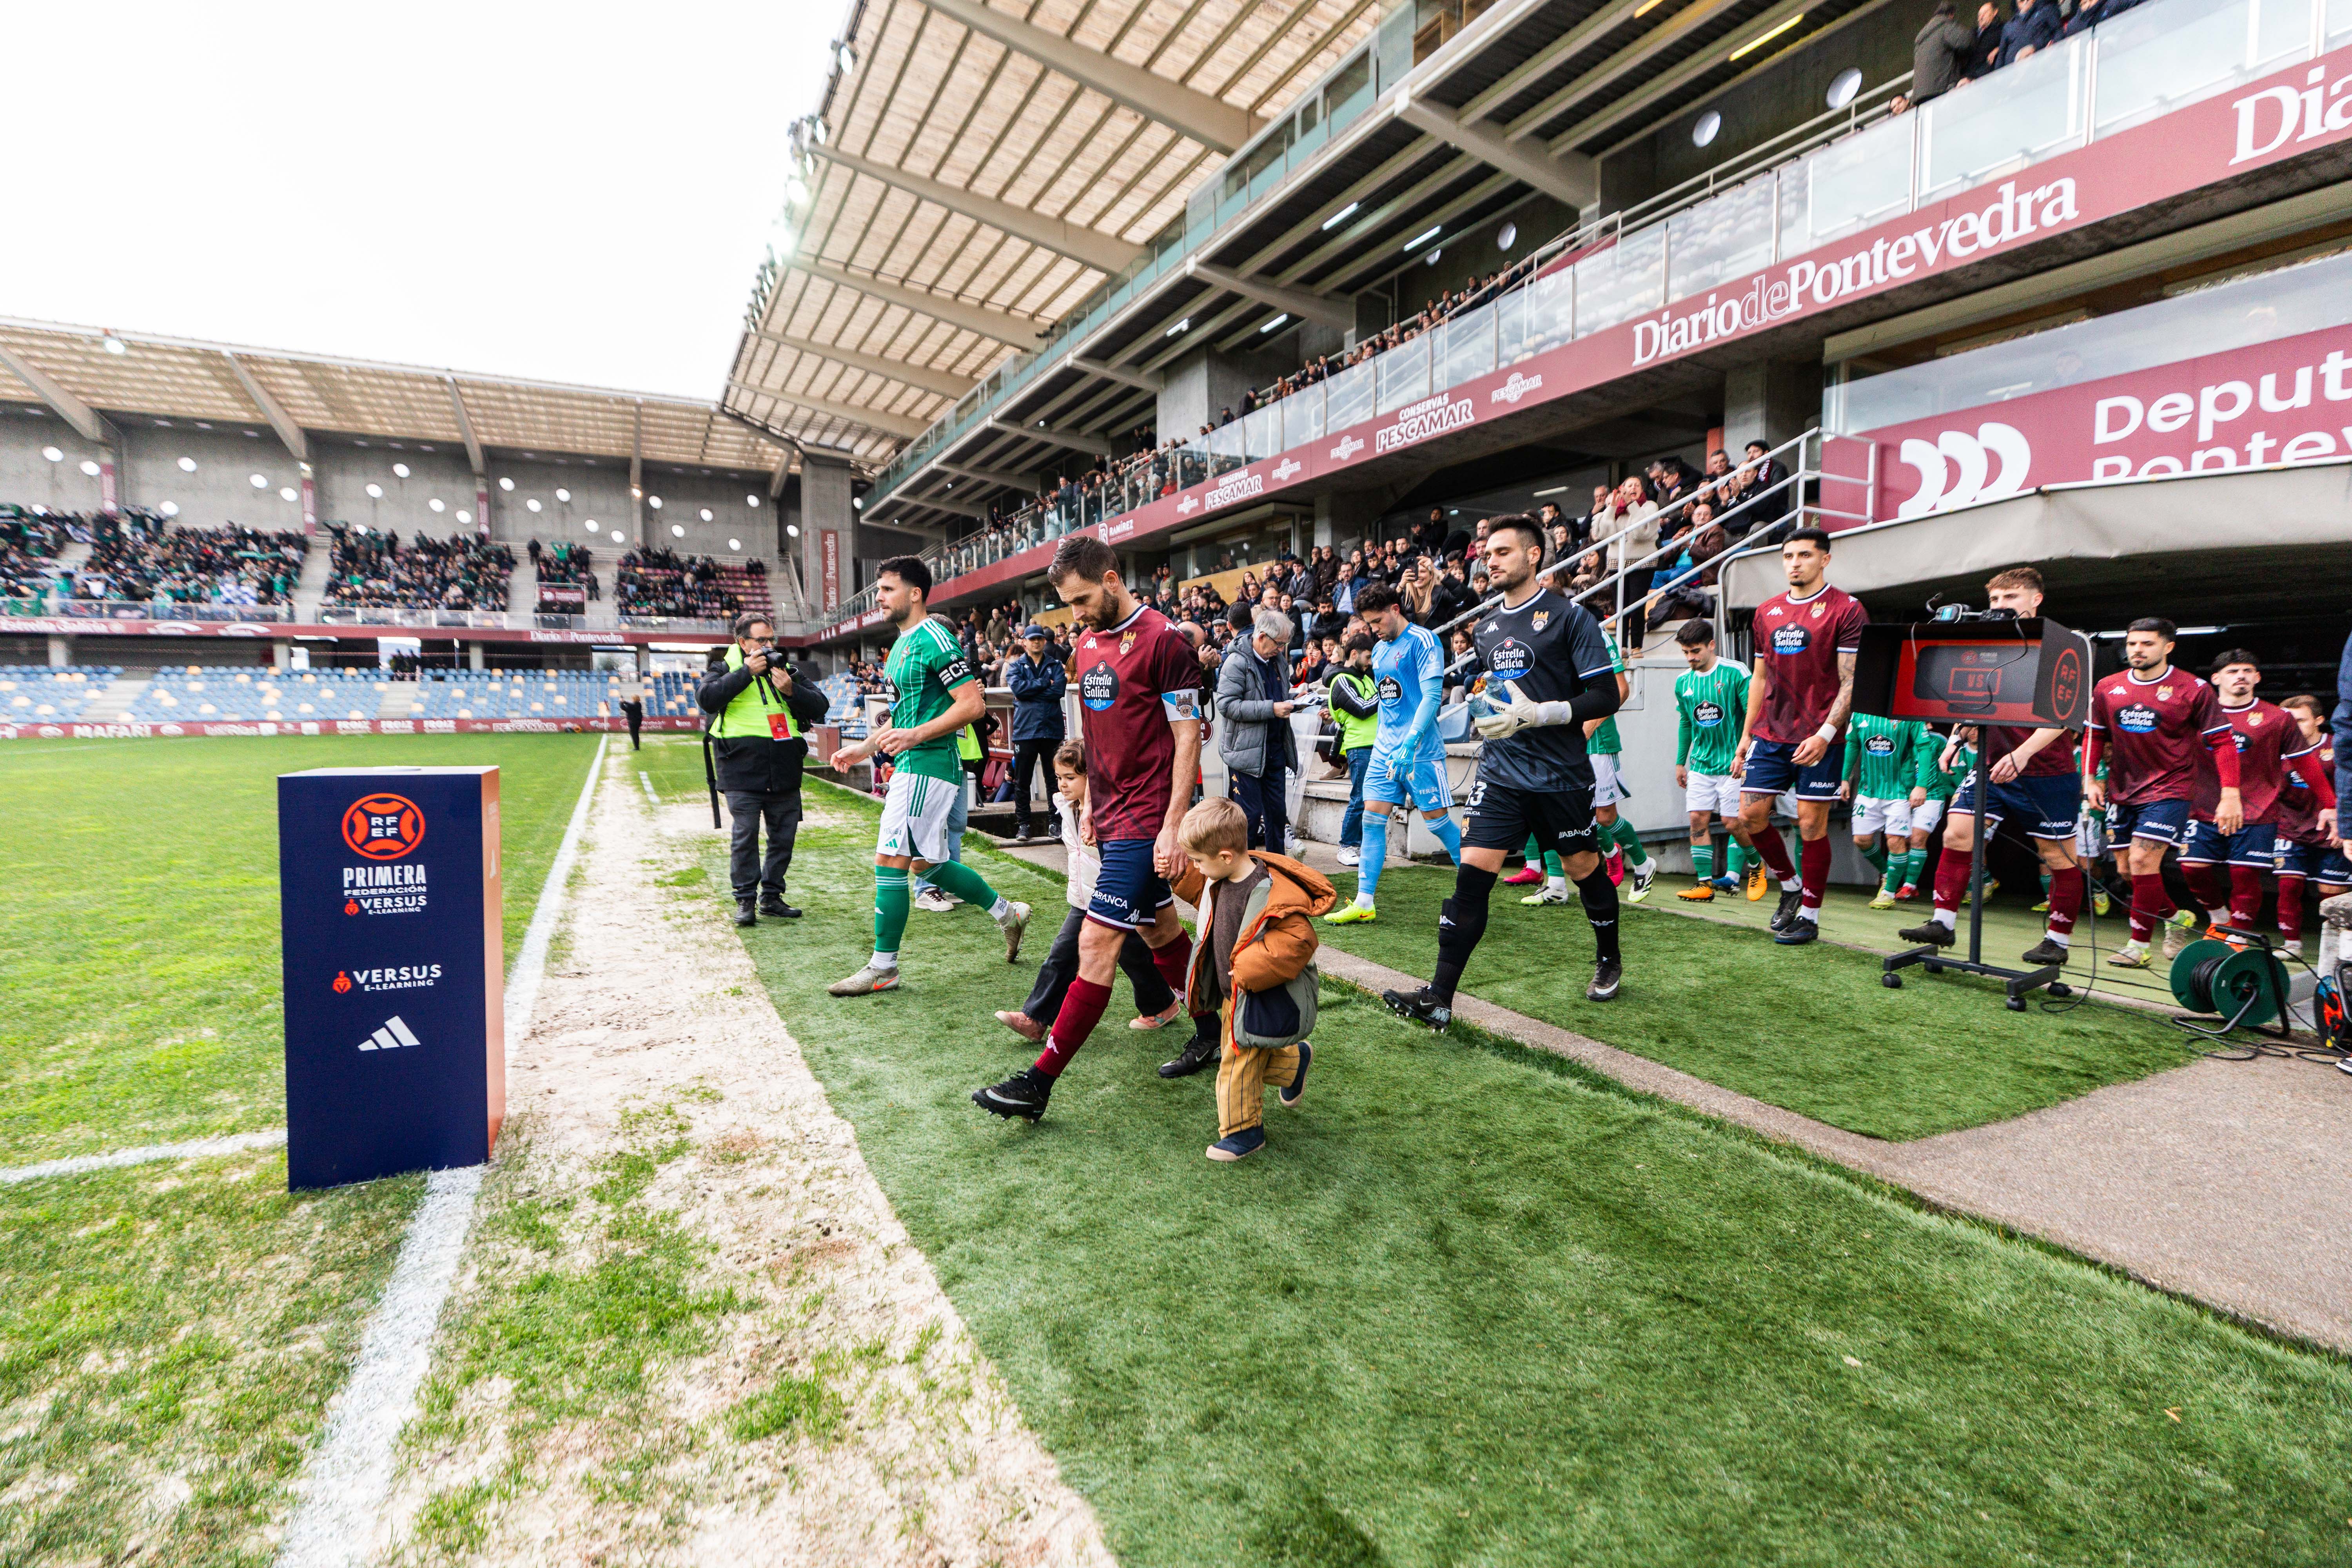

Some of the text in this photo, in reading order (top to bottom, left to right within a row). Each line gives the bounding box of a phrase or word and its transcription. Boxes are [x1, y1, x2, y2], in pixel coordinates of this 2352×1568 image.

[1492, 374, 1543, 404] PESCAMAR
[1399, 393, 1449, 421] CONSERVAS
[1376, 398, 1475, 454] PESCAMAR
[1330, 438, 1364, 459] PESCAMAR
[1272, 461, 1301, 479] PESCAMAR
[1219, 468, 1248, 486] CONSERVAS
[1205, 474, 1263, 510] PESCAMAR
[1109, 519, 1134, 535] RAMÍREZ
[1774, 630, 1804, 639] Estrella
[1775, 637, 1802, 647] Galicia
[1493, 648, 1525, 661] Estrella
[1494, 658, 1524, 671] Galicia
[1083, 673, 1112, 686] Estrella
[1504, 668, 1514, 678] 0,0
[2060, 664, 2076, 682] RF
[1084, 685, 1110, 698] Galicia
[1380, 683, 1397, 691] Estrella
[2057, 684, 2073, 703] EF
[1381, 690, 1397, 699] Galicia
[1093, 698, 1102, 709] 0,0
[1698, 713, 1718, 721] Galicia
[371, 816, 398, 826] RF
[371, 827, 398, 837] EF
[2183, 819, 2199, 837] 3
[343, 864, 427, 888] PRIMERA
[344, 885, 427, 896] FEDERACIÓN
[359, 895, 427, 909] VERSUS
[368, 907, 421, 915] E-LEARNING
[353, 964, 442, 984] VERSUS
[364, 979, 434, 991] E-LEARNING
